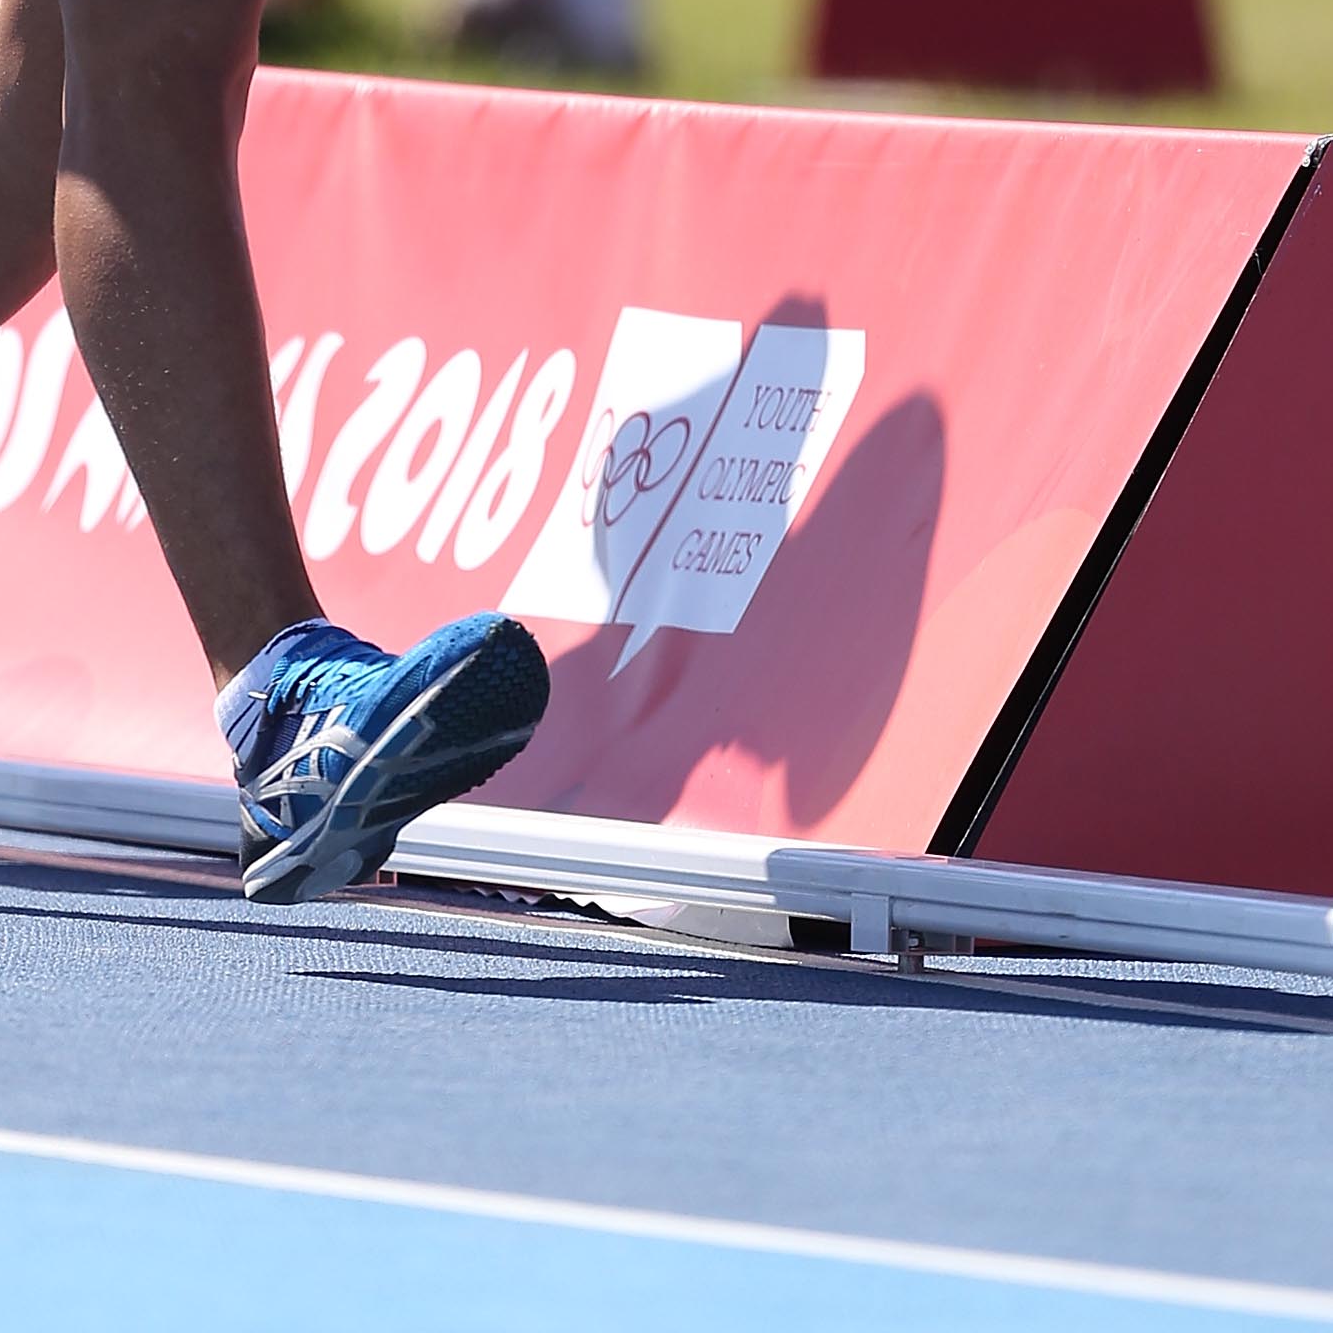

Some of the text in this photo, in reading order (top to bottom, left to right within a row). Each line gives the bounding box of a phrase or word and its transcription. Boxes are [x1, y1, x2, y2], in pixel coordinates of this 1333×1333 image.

[743, 384, 832, 432] YOUTH
[303, 336, 577, 571] 2018
[696, 456, 807, 506] OLYMPIC
[672, 528, 763, 576] GAMES
